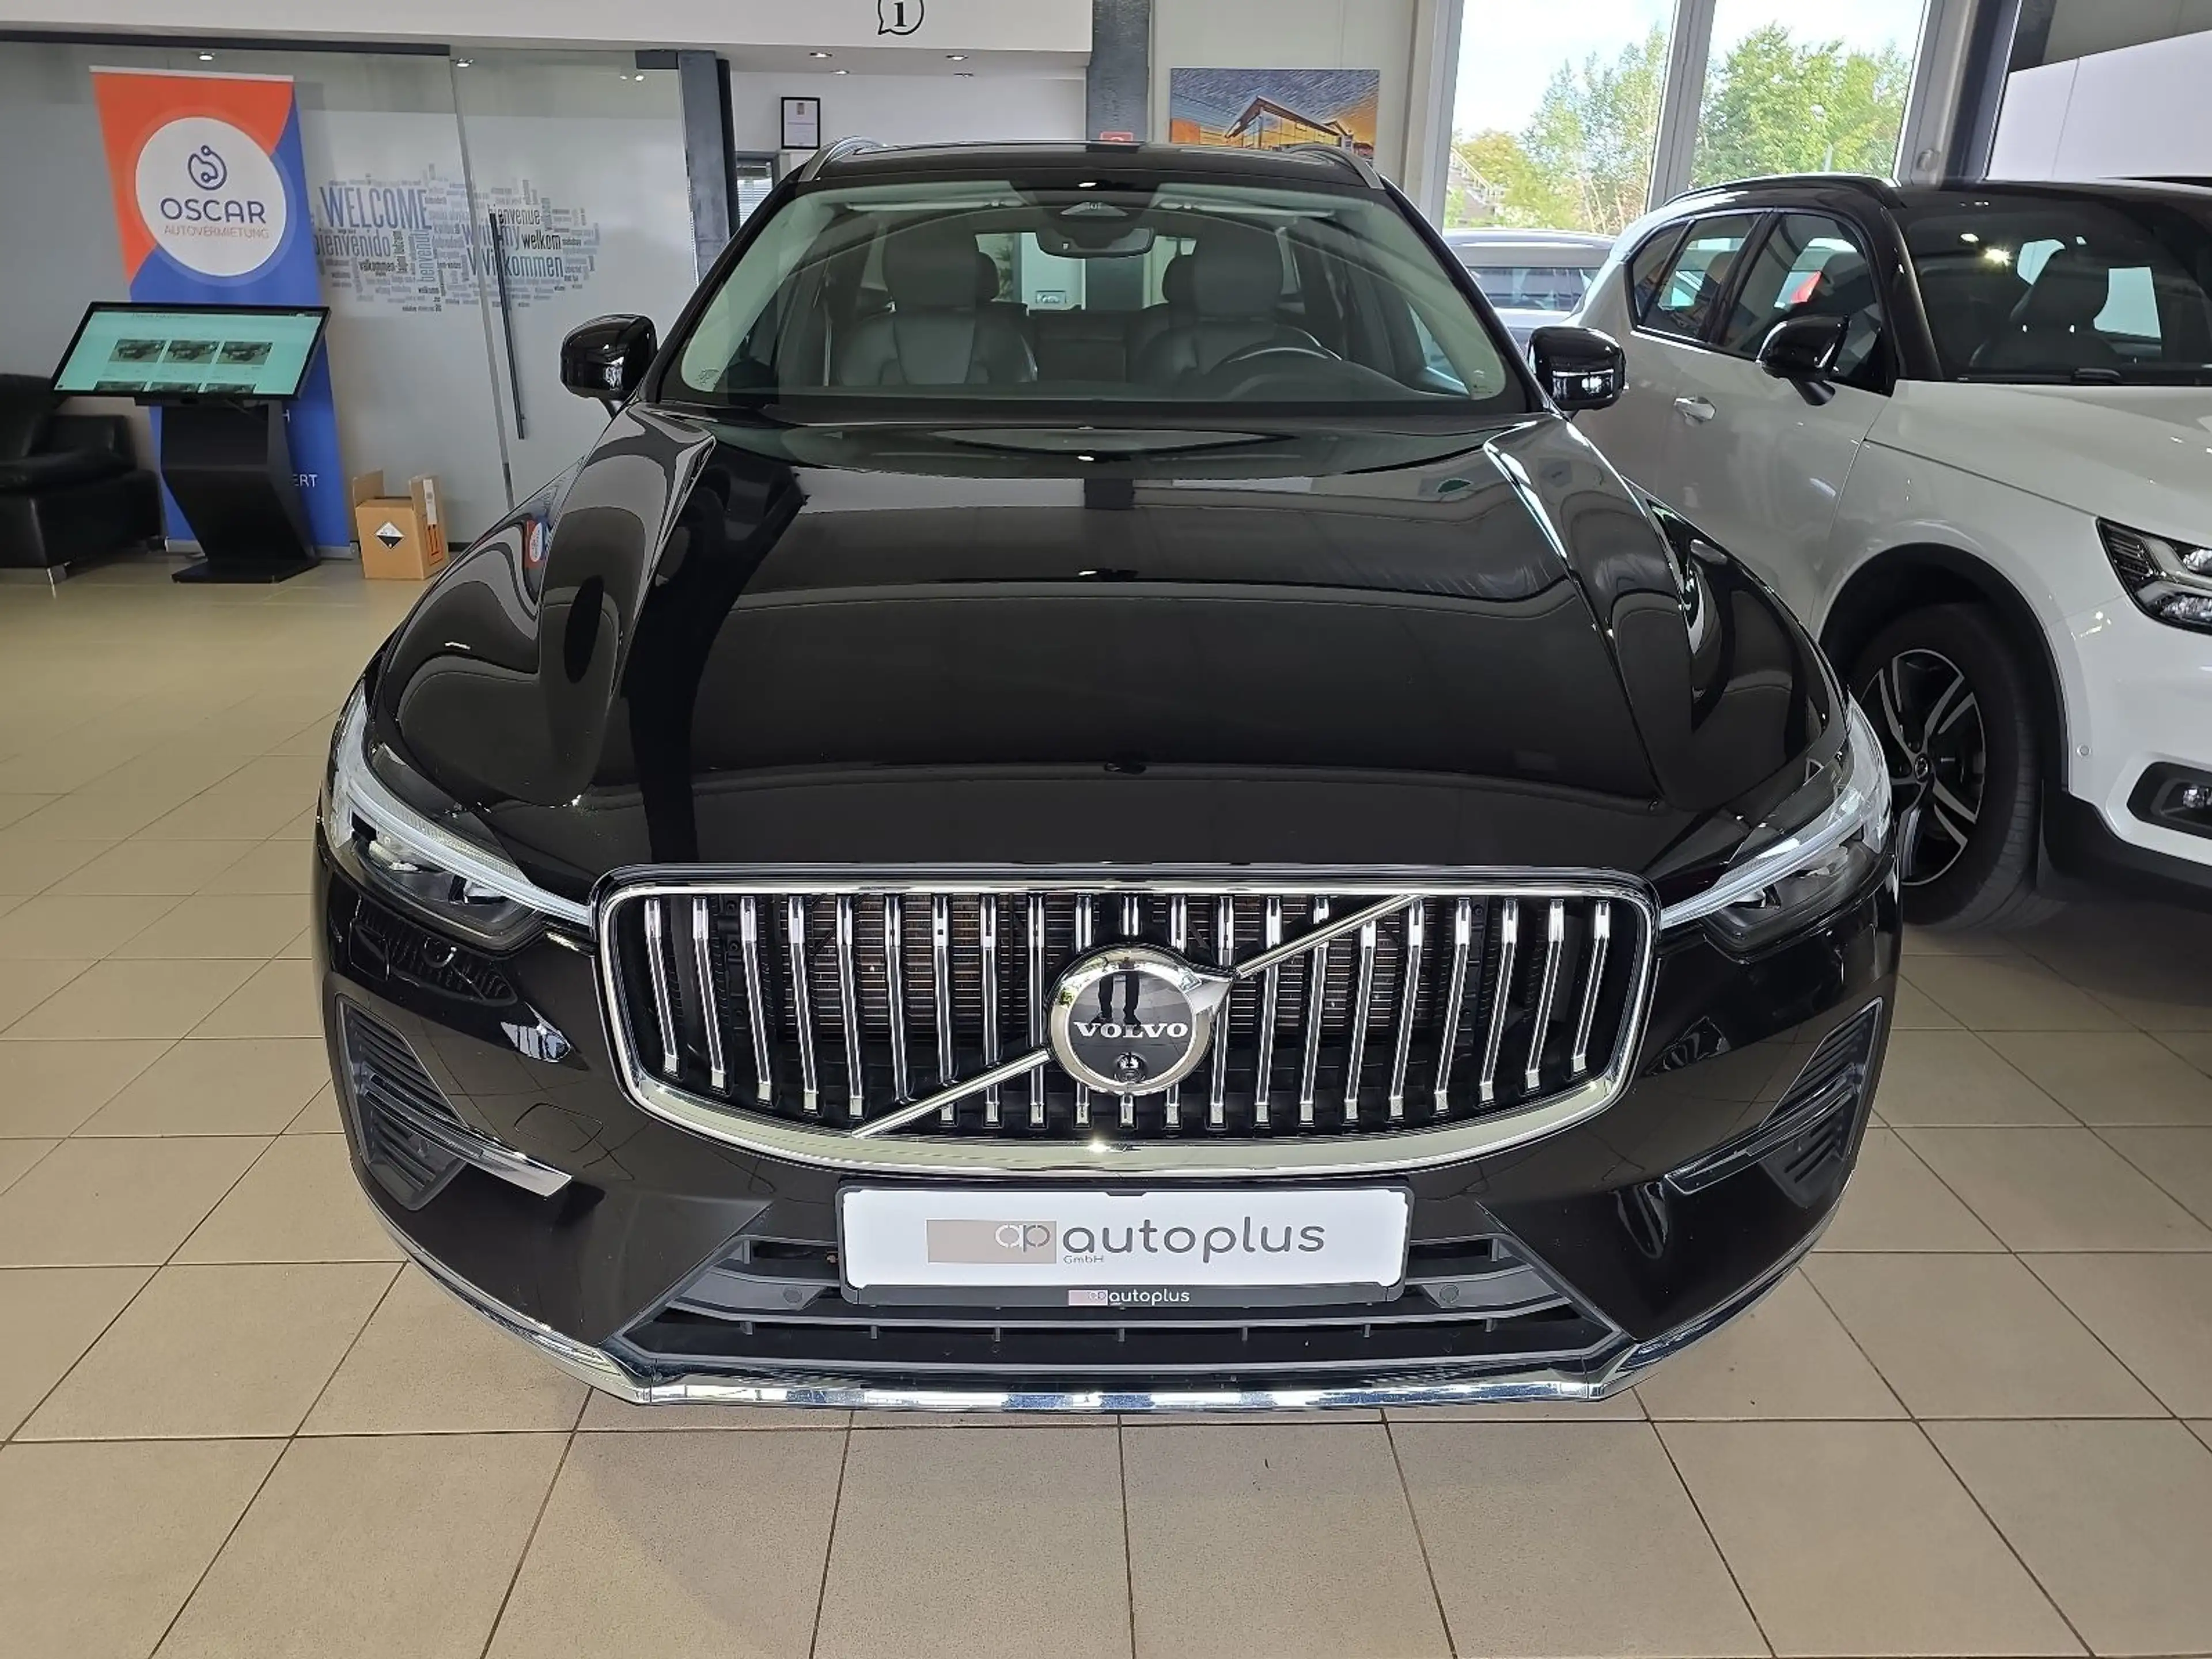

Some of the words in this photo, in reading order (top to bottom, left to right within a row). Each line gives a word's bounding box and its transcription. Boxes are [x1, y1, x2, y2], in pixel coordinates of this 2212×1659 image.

[160, 198, 266, 224] OSCAR
[319, 186, 432, 230] WELCOME
[164, 225, 270, 239] AUTOVERMIETUNG
[521, 229, 562, 250] welkom
[467, 248, 565, 277] Wikommen
[1073, 1021, 1188, 1038] VOLVO
[1063, 1216, 1325, 1264] autoplus
[1063, 1255, 1104, 1264] GmbH
[1108, 1288, 1191, 1306] autoplus
